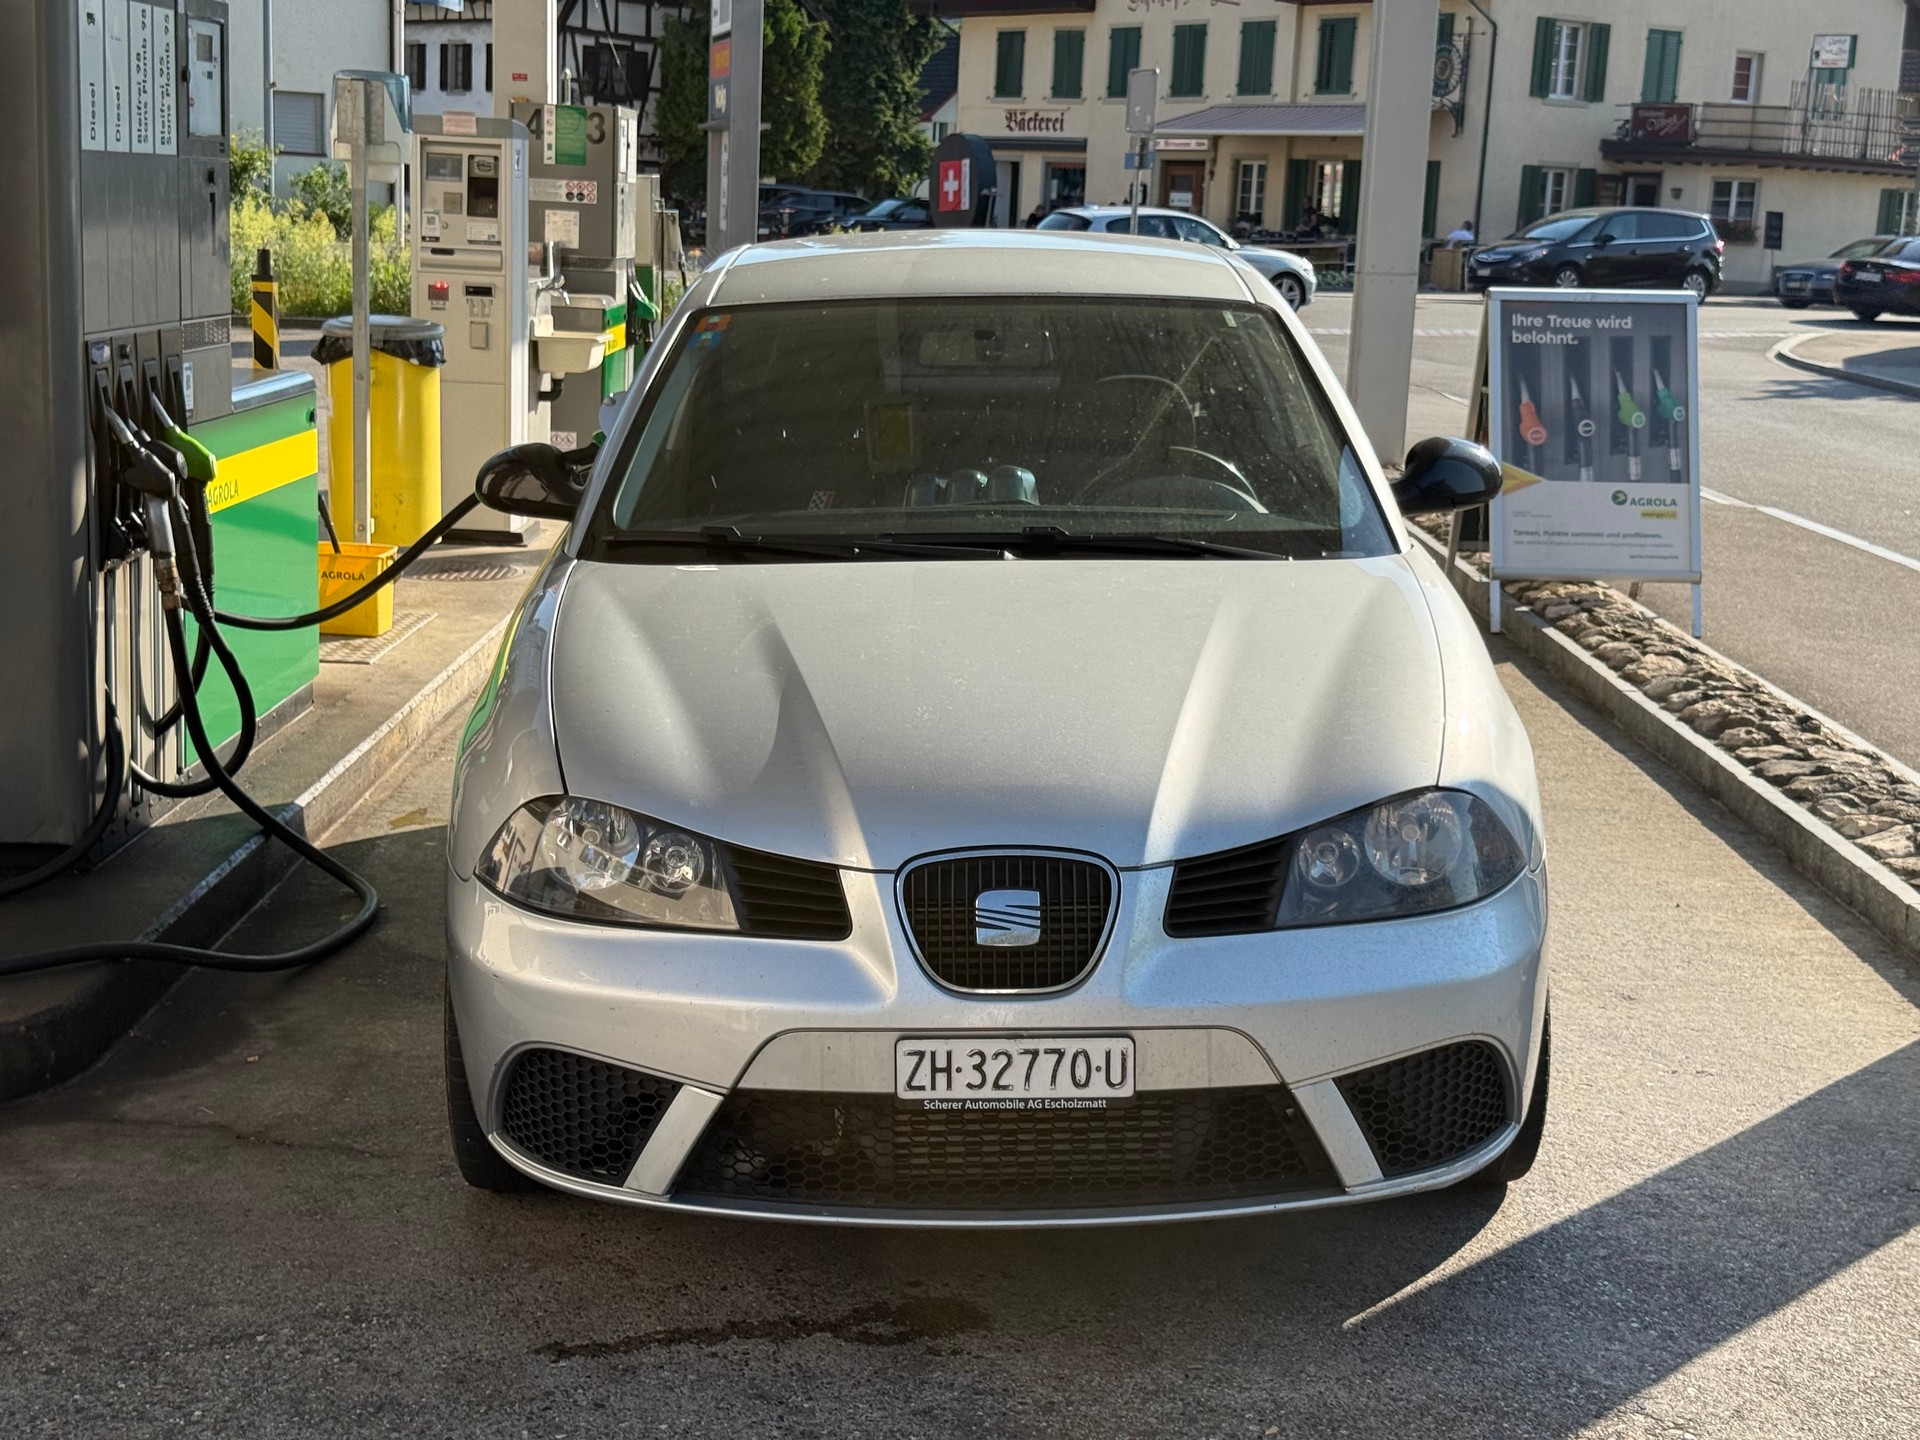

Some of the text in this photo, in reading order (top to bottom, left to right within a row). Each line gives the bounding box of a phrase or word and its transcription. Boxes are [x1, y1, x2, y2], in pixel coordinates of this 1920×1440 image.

[141, 8, 147, 31] 98
[164, 13, 169, 36] 95
[136, 52, 142, 75] 98
[159, 56, 164, 78] 95
[527, 108, 543, 140] 4
[586, 112, 606, 145] 3
[1005, 111, 1064, 132] Bäckerei
[1512, 313, 1632, 329] Ihre Treue wird
[1512, 330, 1578, 345] belohnt.
[1629, 497, 1677, 507] AGROLA
[321, 571, 365, 582] AGROLA
[923, 1099, 1107, 1110] Scherer Automobile AG Escholzmatt
